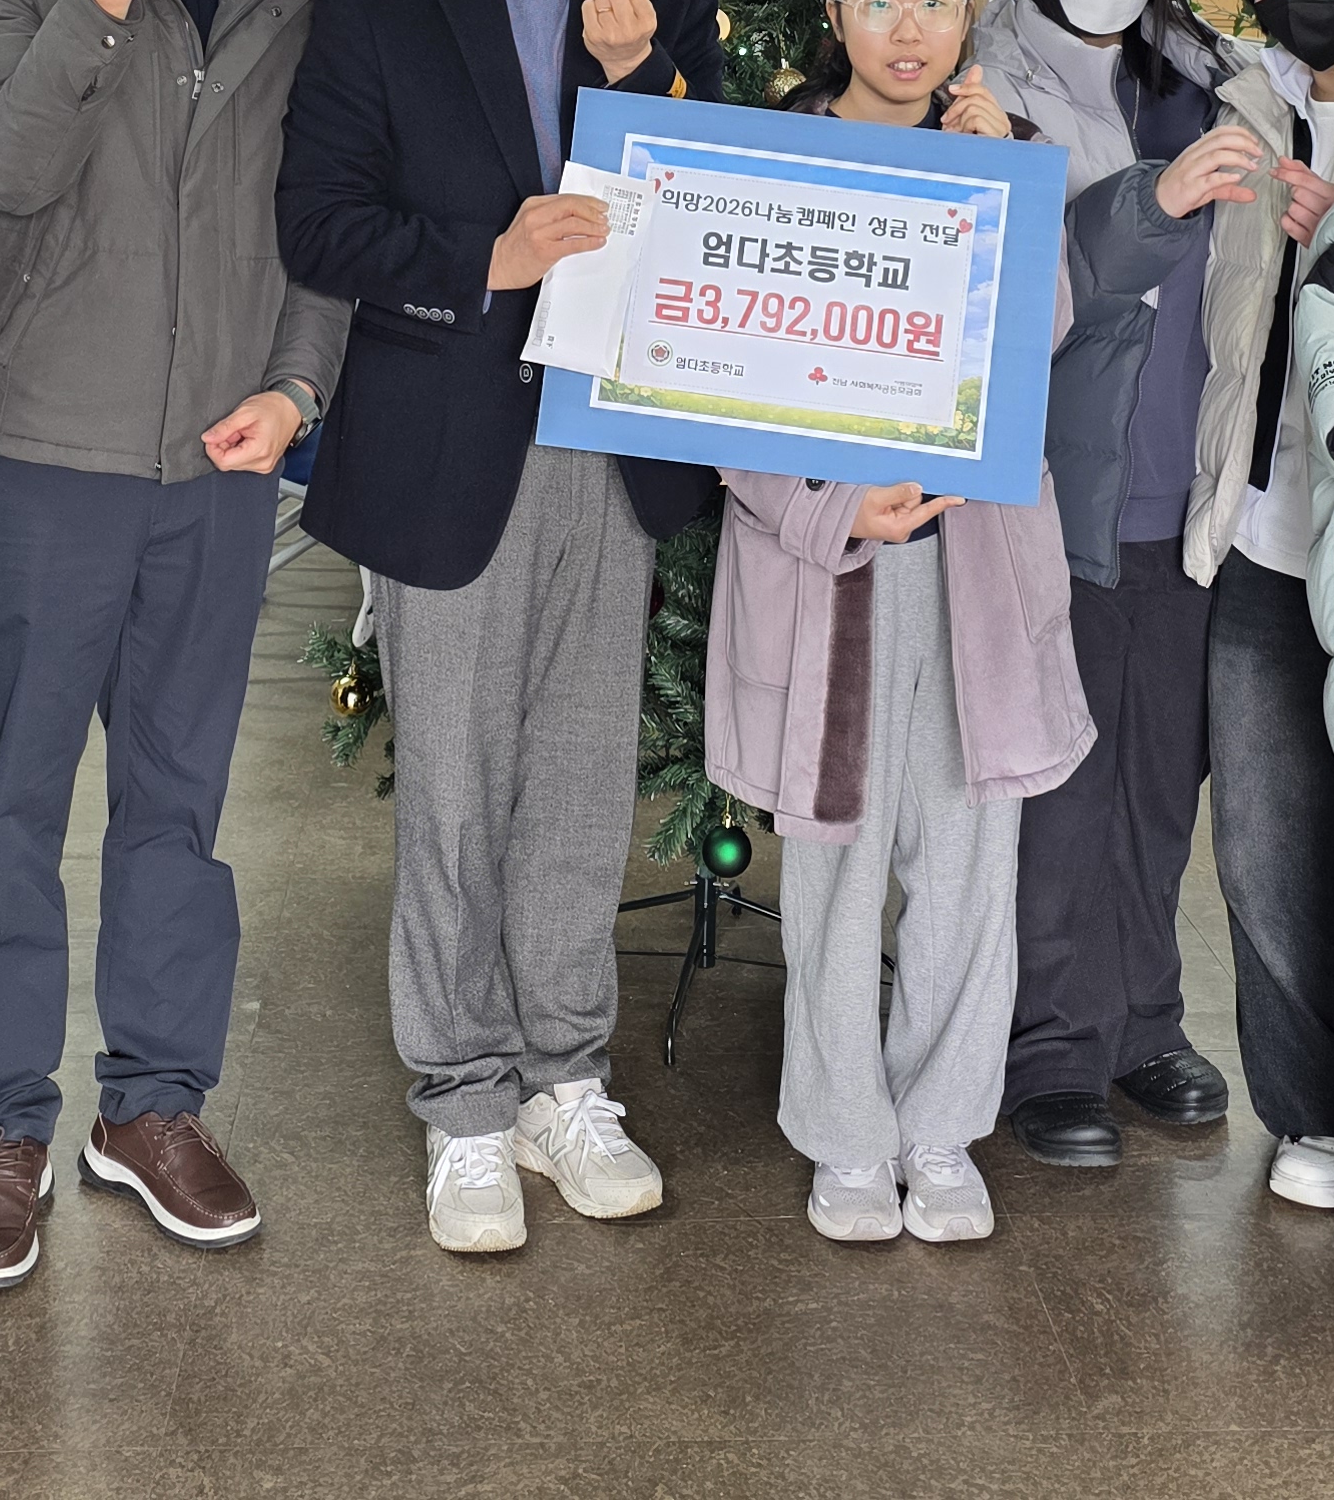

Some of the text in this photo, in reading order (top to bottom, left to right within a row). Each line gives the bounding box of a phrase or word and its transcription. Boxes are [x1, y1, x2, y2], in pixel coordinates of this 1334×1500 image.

[661, 189, 856, 232] 희망2026나눔캠페인
[868, 216, 908, 239] 성금
[920, 223, 960, 247] 전달
[702, 231, 912, 290] 엄다초등학교
[654, 277, 944, 357] 금3,792,000원
[676, 357, 744, 378] 엄다초등학교
